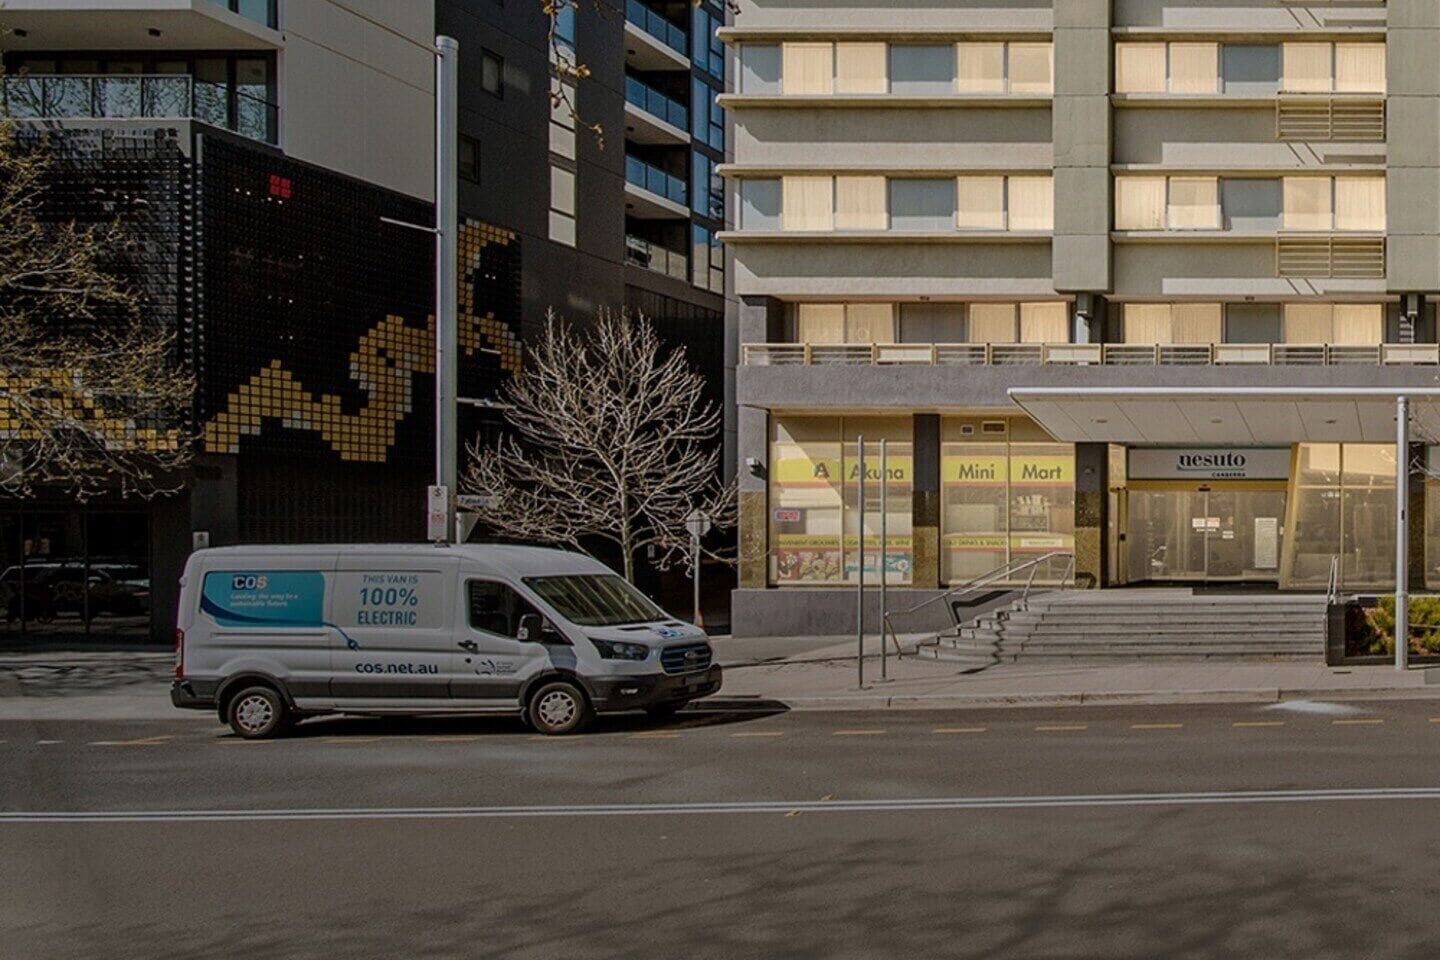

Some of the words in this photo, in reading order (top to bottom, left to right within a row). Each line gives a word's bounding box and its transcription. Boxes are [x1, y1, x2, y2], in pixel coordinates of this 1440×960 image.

[1178, 452, 1246, 468] nesuto
[814, 461, 830, 478] A
[958, 463, 995, 480] Mini
[1021, 464, 1062, 480] Mart
[362, 574, 385, 584] THIS
[387, 574, 407, 584] VAN
[408, 574, 419, 584] IS
[359, 587, 419, 607] 100%
[358, 610, 417, 626] ELECTRIC
[355, 662, 439, 675] cos.net.au
